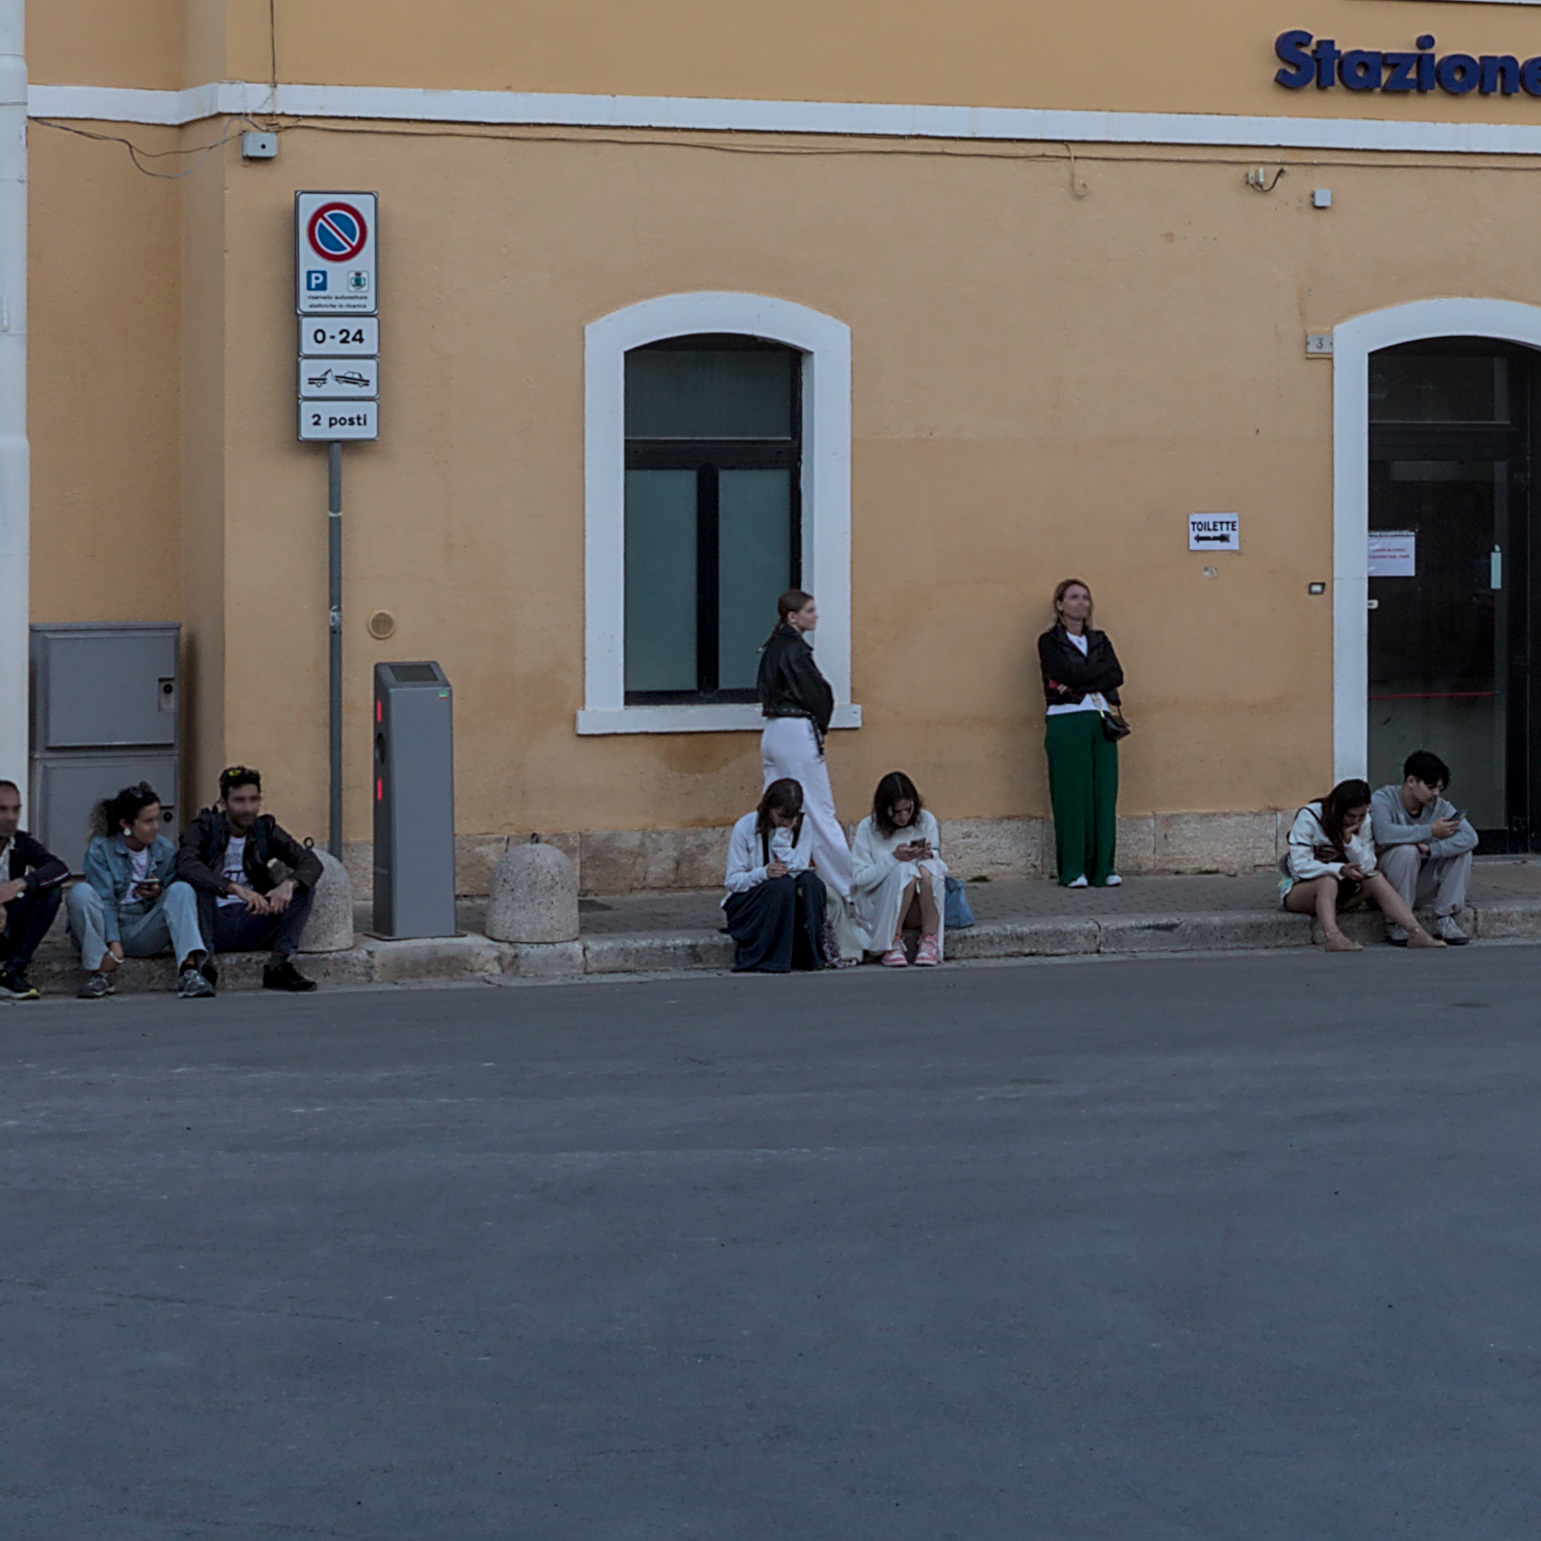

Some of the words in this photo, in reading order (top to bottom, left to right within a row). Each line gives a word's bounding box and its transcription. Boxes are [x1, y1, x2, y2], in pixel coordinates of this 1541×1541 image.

[311, 272, 324, 289] P
[1316, 337, 1324, 350] 3
[311, 413, 322, 426] 2
[328, 413, 368, 429] posti
[1191, 521, 1237, 531] TOILETTE
